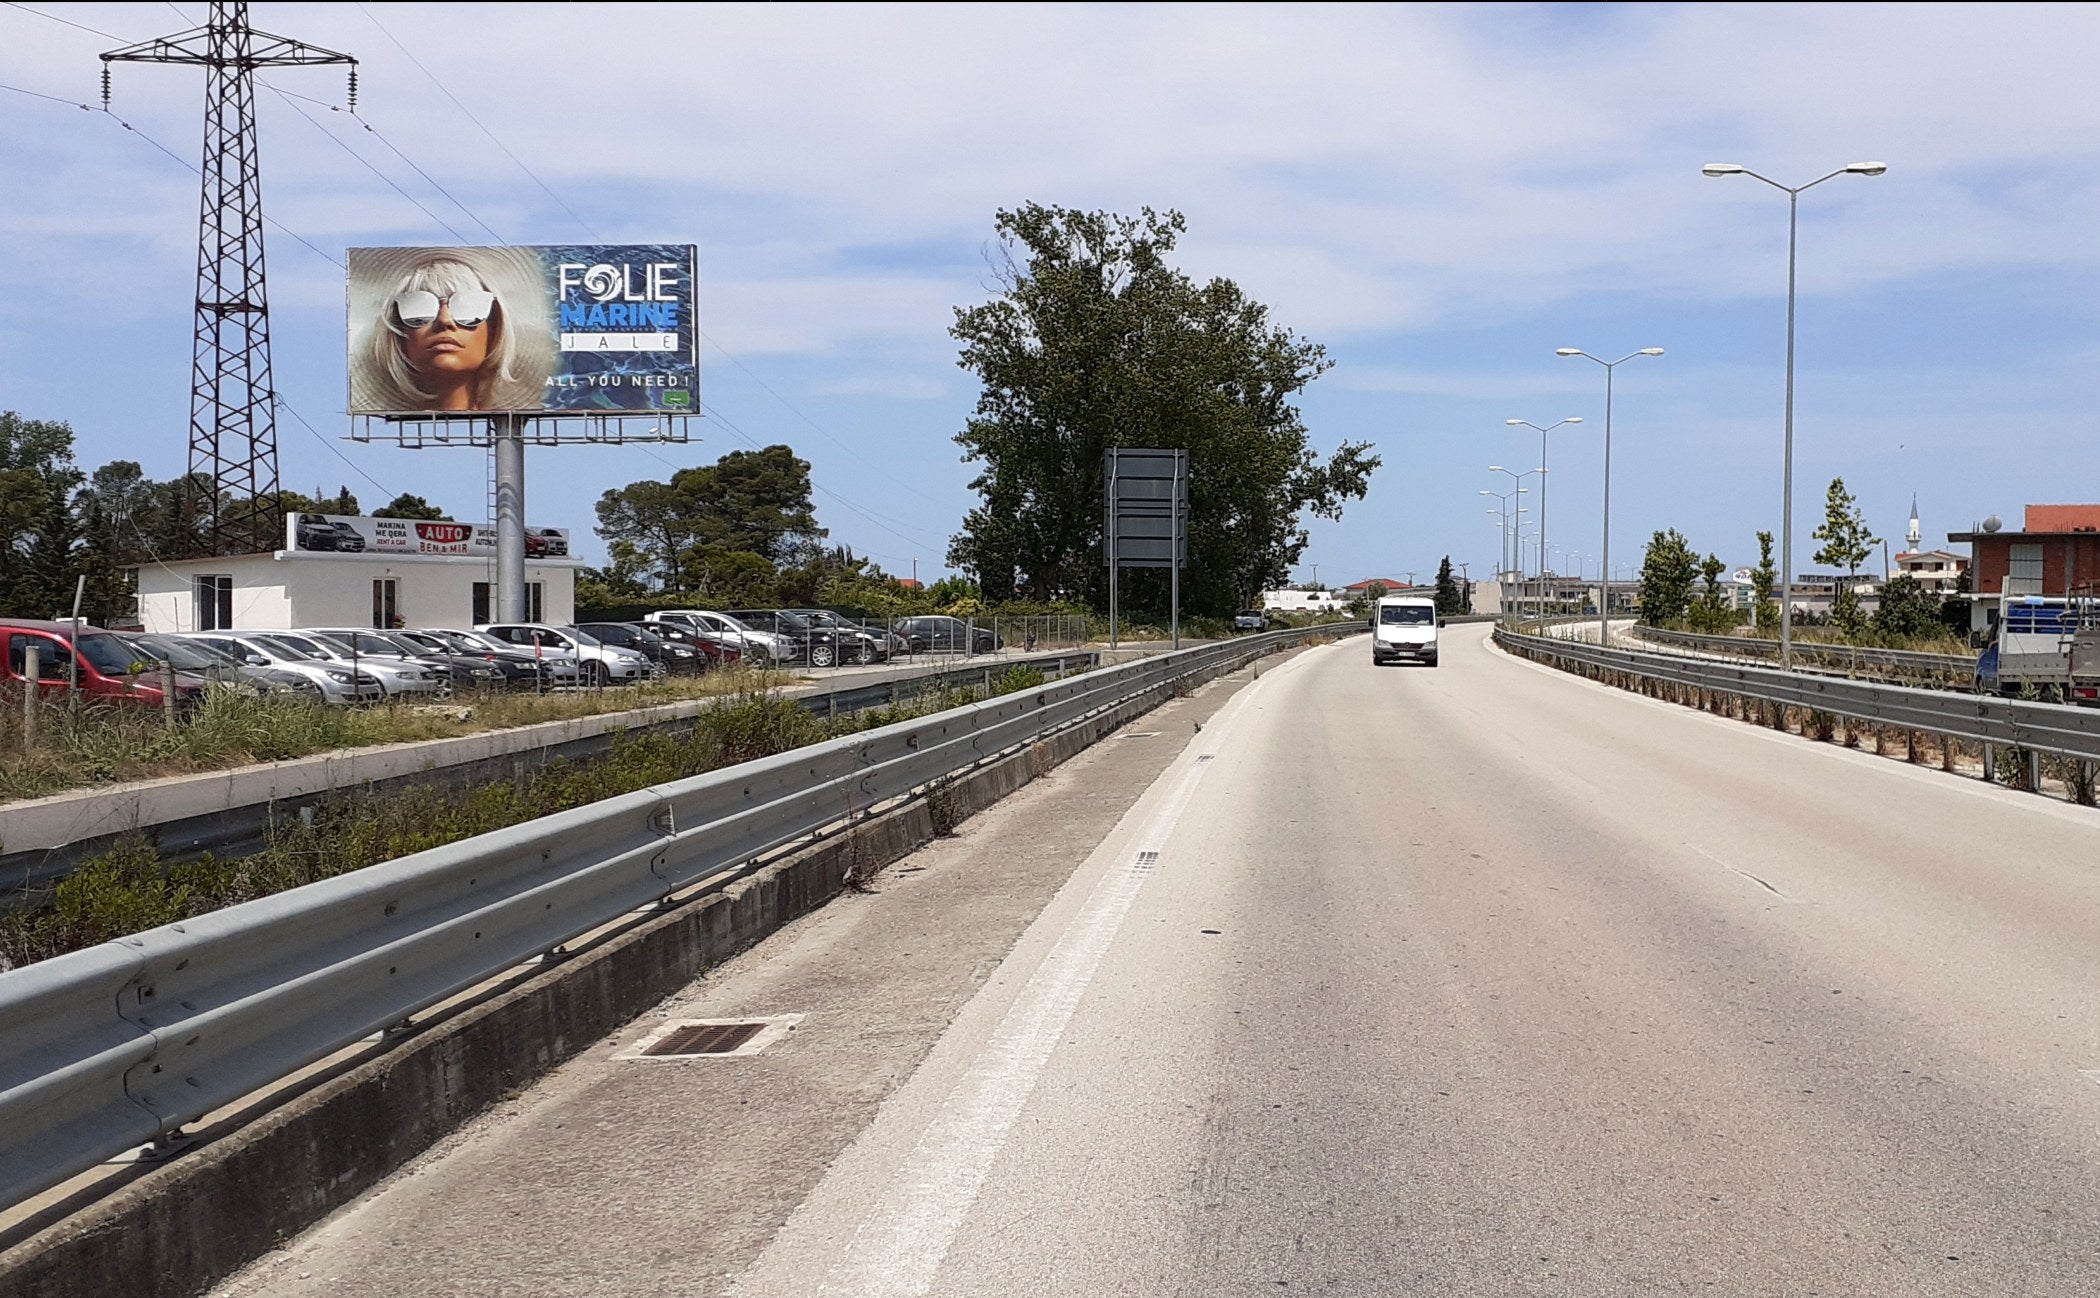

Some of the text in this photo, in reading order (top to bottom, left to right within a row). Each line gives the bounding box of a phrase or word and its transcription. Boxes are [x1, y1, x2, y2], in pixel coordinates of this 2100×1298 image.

[560, 263, 678, 301] FOLIE
[560, 303, 679, 326] MARINE
[568, 336, 671, 349] JALE
[545, 376, 577, 386] ALL
[588, 375, 621, 387] YOU
[425, 526, 463, 540] AUTO
[420, 542, 439, 552] BEN
[450, 543, 468, 553] MIR
